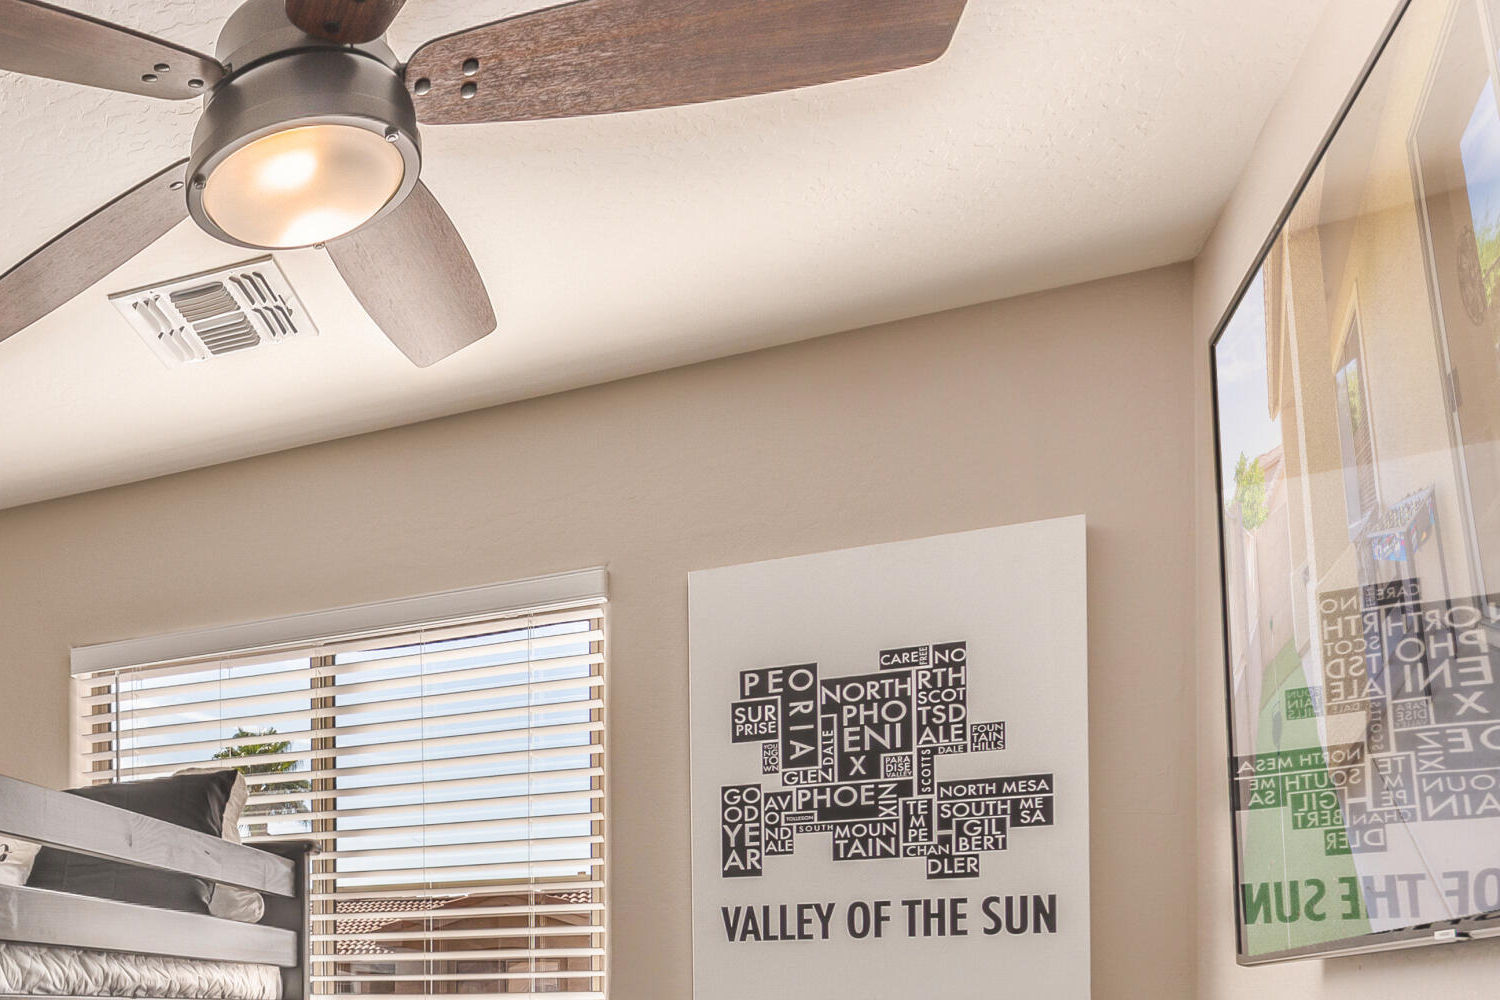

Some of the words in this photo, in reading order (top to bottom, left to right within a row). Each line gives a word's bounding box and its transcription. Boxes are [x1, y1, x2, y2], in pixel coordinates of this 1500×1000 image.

[880, 652, 918, 666] CARE
[919, 646, 928, 665] FREE
[934, 648, 966, 664] NO
[744, 669, 814, 697] PEO
[918, 666, 966, 690] RTH
[821, 677, 912, 705] NORTH
[918, 688, 966, 704] SCOT
[734, 704, 777, 724] SUR
[842, 700, 907, 726] PHO
[918, 704, 966, 726] TSD
[736, 721, 777, 736] PRISE
[788, 700, 816, 760] RIA
[918, 724, 964, 745] ALE
[972, 723, 1004, 733] FOUN
[844, 723, 902, 752] ENI
[972, 731, 1004, 743] TAIN
[972, 740, 1004, 751] HILLS
[822, 730, 834, 766] DALE
[938, 745, 964, 754] DALE
[764, 756, 779, 766] TO
[849, 755, 866, 776] X
[886, 756, 911, 764] PARA
[886, 763, 911, 773] DISE
[783, 768, 833, 785] GLEN
[886, 770, 912, 778] VALLEY
[921, 749, 932, 793] SCOTTS
[724, 787, 762, 806] GO
[940, 782, 996, 798] NORTH
[1002, 778, 1050, 794] MESA
[764, 795, 792, 812] AV
[906, 800, 928, 815] TE
[940, 800, 1011, 818] SOUTH
[1020, 798, 1044, 810] ME
[724, 806, 759, 824] OD
[765, 812, 780, 825] O
[910, 815, 926, 828] M
[1020, 810, 1046, 824] SA
[722, 822, 760, 848] YE
[765, 827, 792, 841] ND
[798, 824, 834, 833] SOUTH
[834, 822, 898, 839] MOUN
[908, 828, 928, 842] PE
[963, 818, 1002, 836] GIL
[765, 840, 794, 853] ALE
[835, 836, 897, 858] TAIN
[906, 844, 950, 857] CHAN
[958, 834, 1006, 851] BERT
[724, 849, 762, 872] AR
[927, 857, 979, 875] DLER
[721, 902, 836, 942] VALLEY
[846, 900, 892, 939] OF
[901, 898, 968, 938] THE
[981, 894, 1057, 936] SUN
